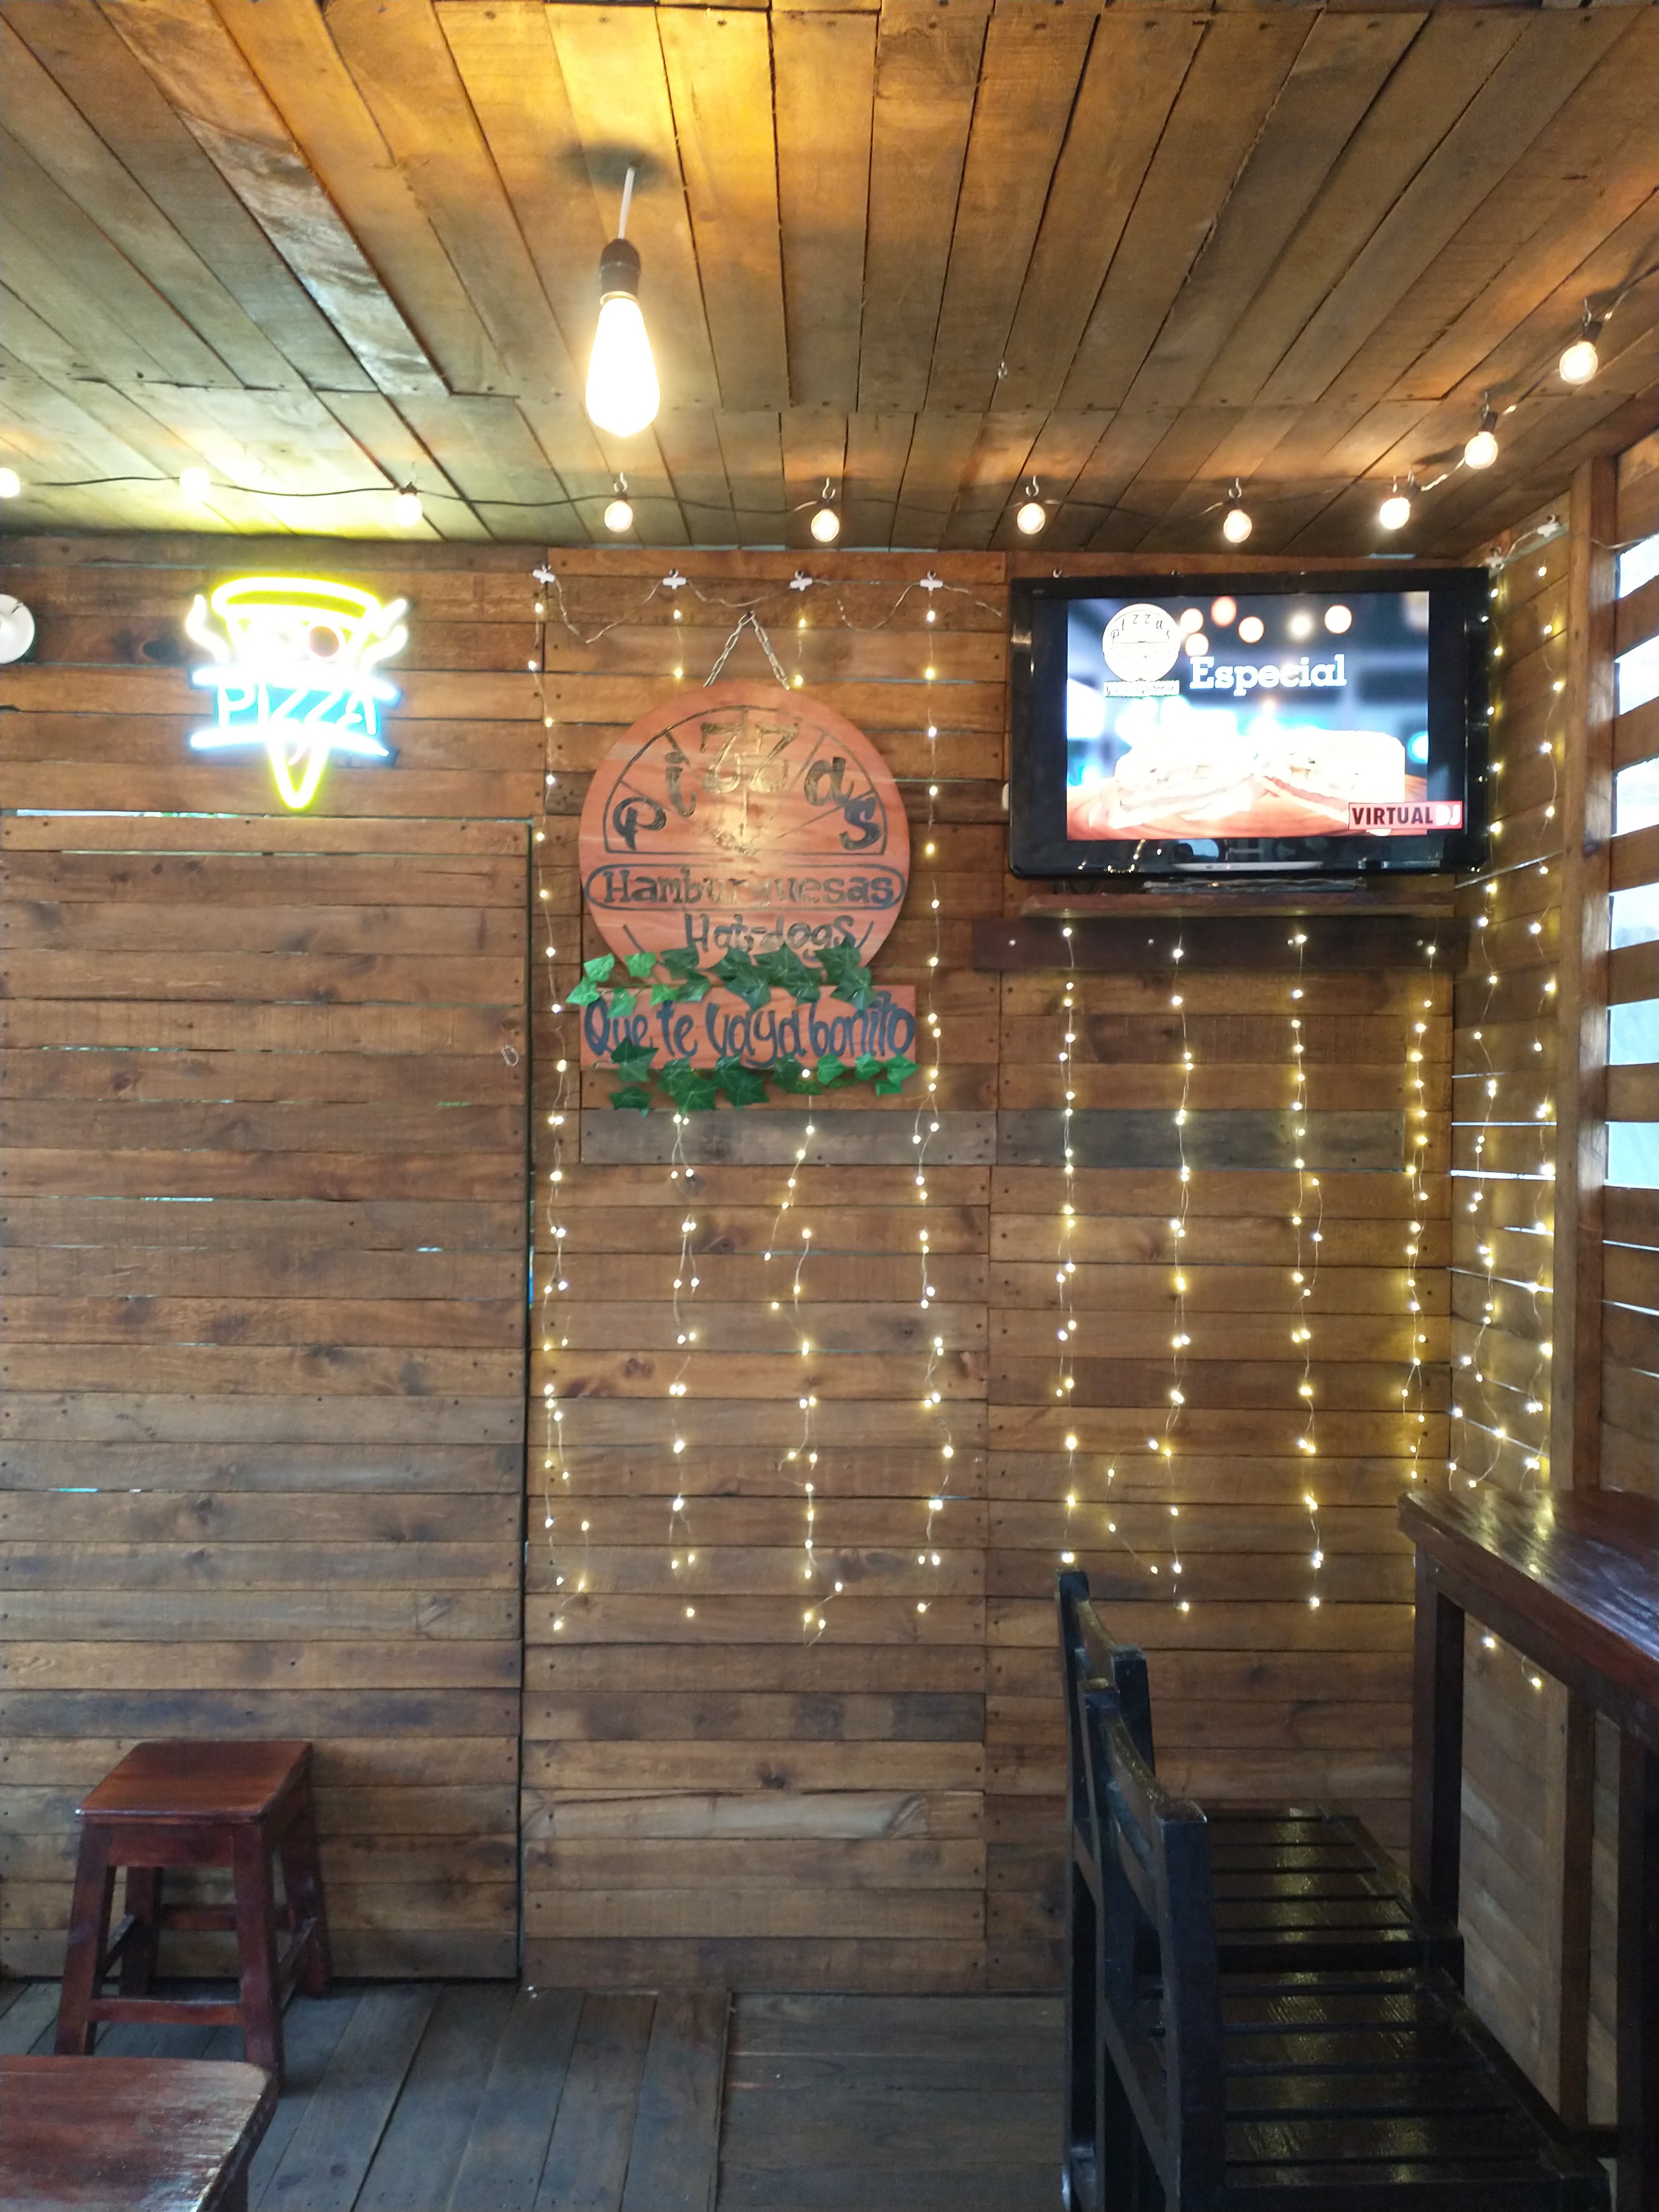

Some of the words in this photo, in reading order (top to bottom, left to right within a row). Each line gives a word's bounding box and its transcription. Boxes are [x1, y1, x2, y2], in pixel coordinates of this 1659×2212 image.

[1190, 653, 1347, 696] Especial
[216, 682, 378, 735] PIZZA
[584, 996, 652, 1056] Que
[657, 1000, 697, 1057] te
